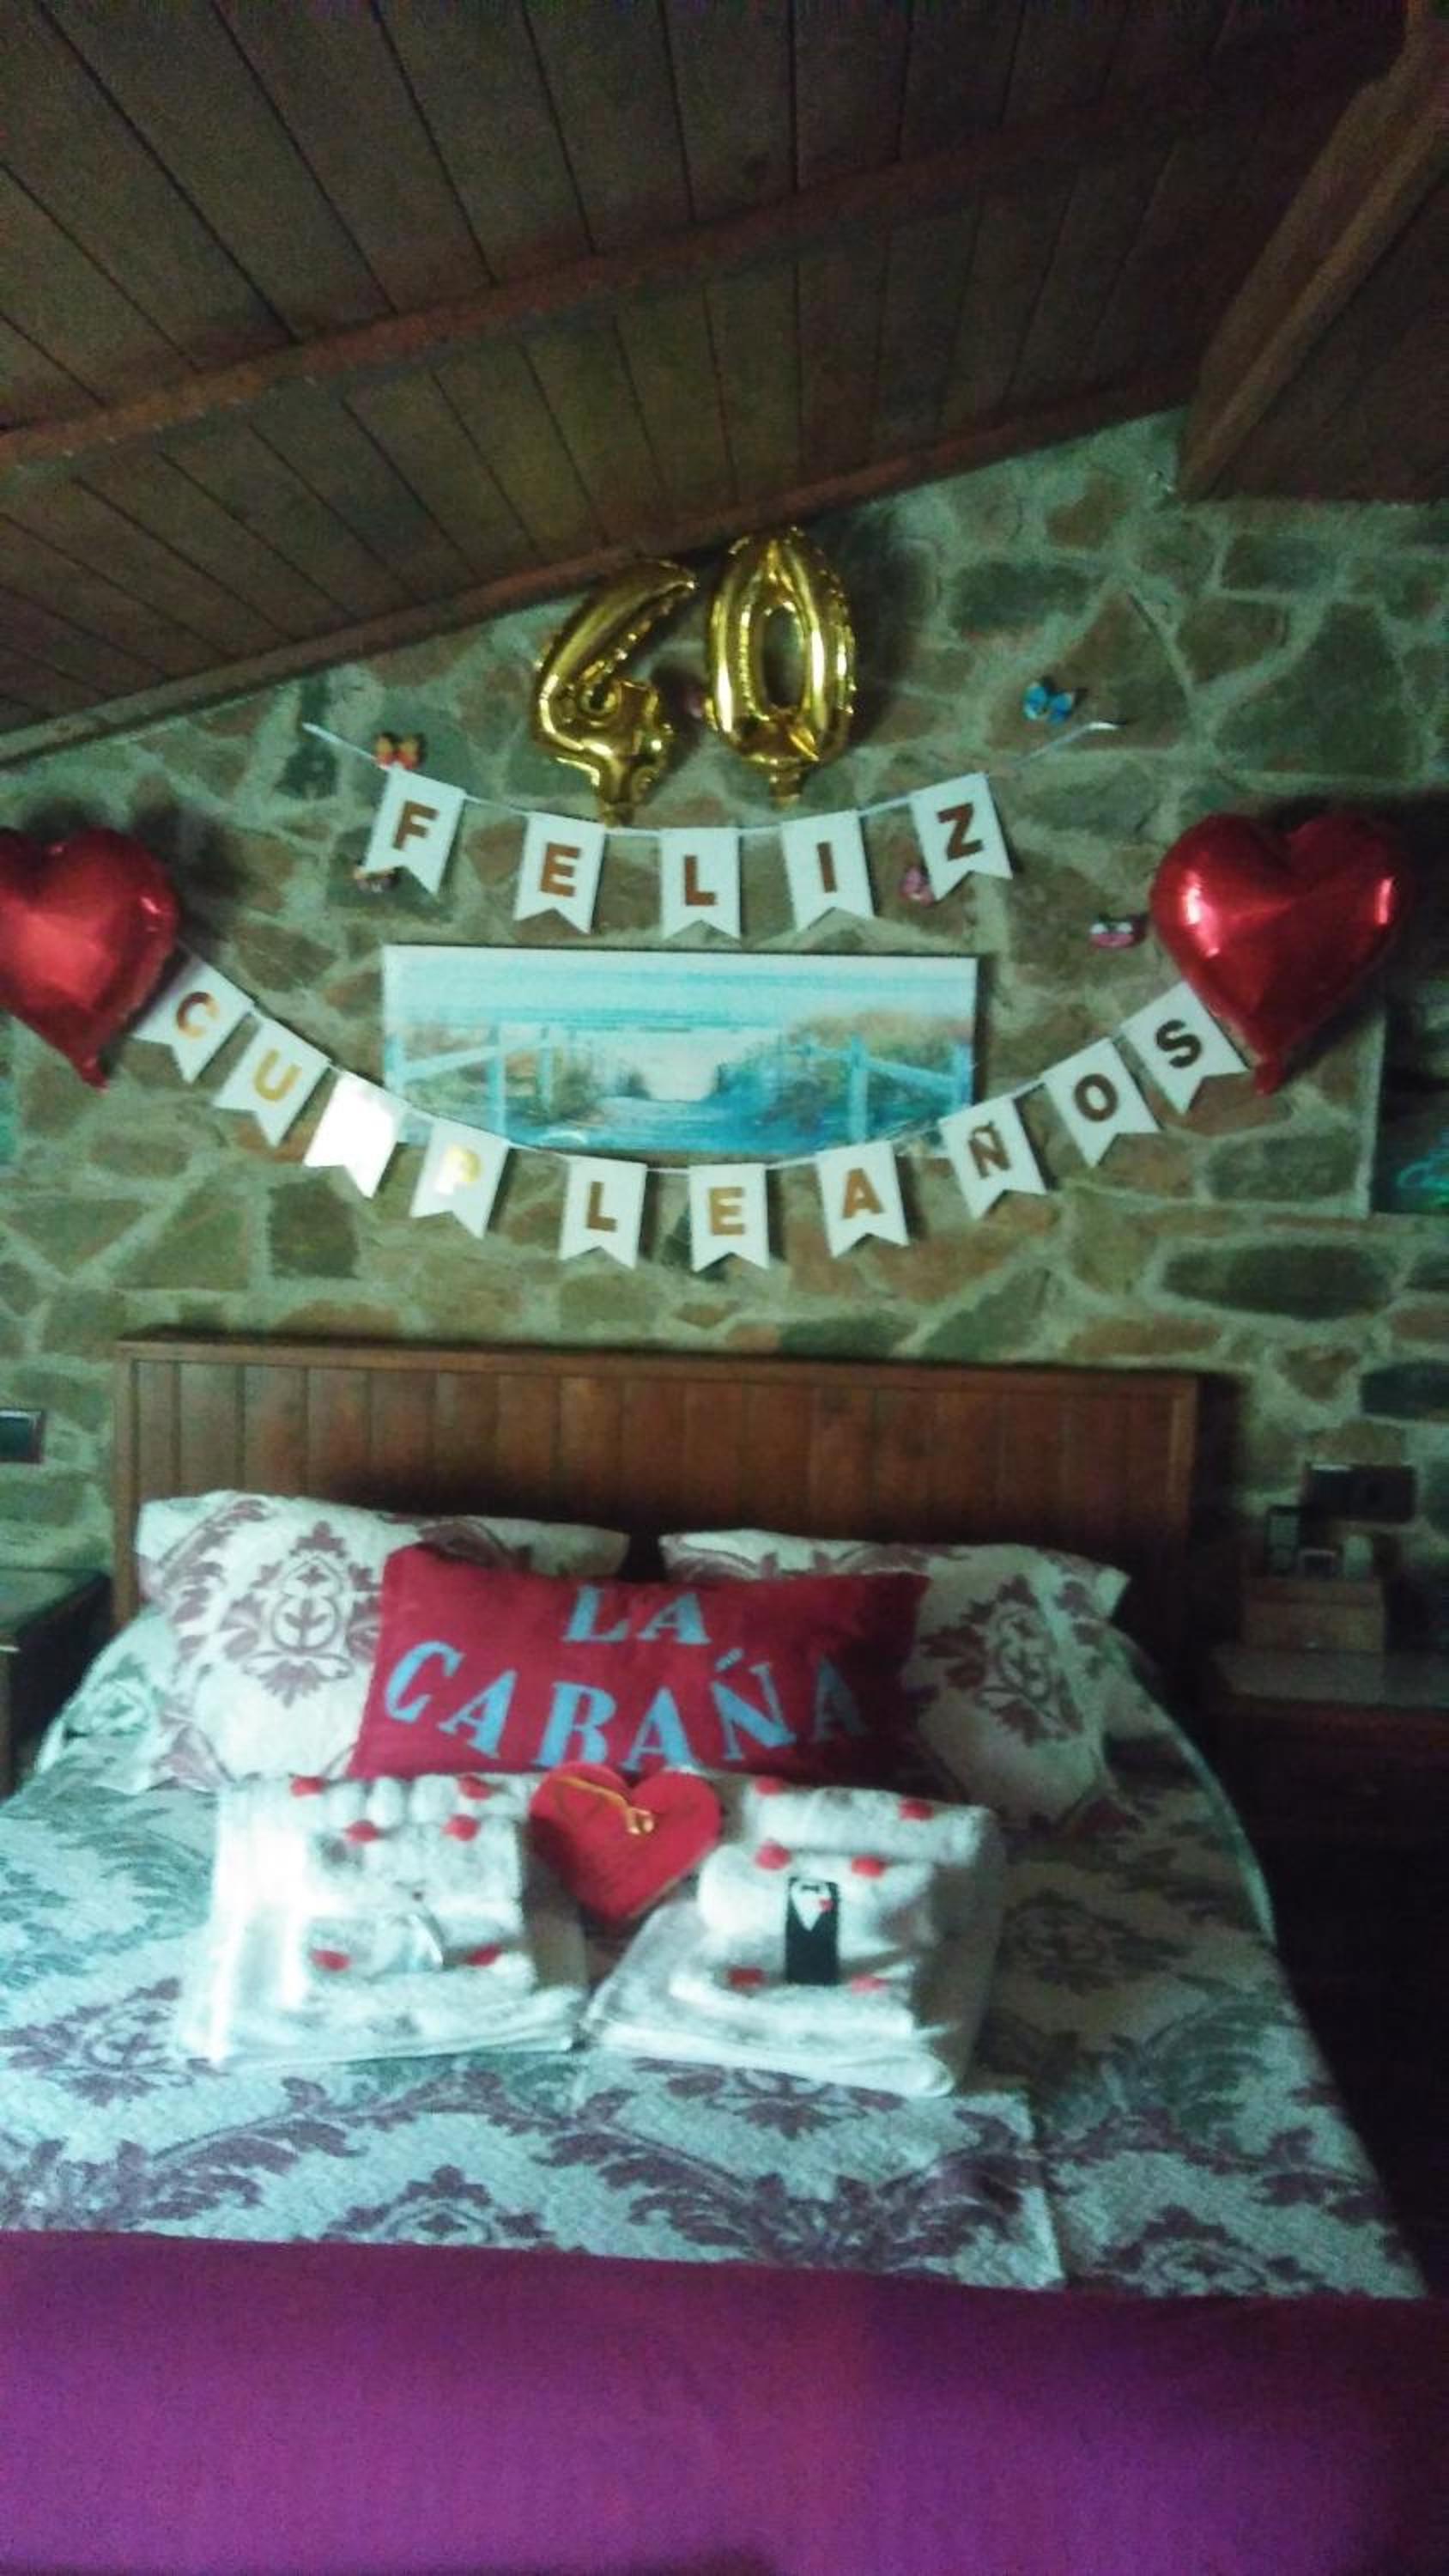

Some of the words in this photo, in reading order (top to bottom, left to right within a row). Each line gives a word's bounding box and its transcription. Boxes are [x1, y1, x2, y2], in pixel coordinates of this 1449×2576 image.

[534, 527, 856, 811] 40
[393, 800, 985, 908] FELIZ
[174, 990, 1202, 1236] CUPLEAÑOS
[562, 1584, 710, 1644] LA
